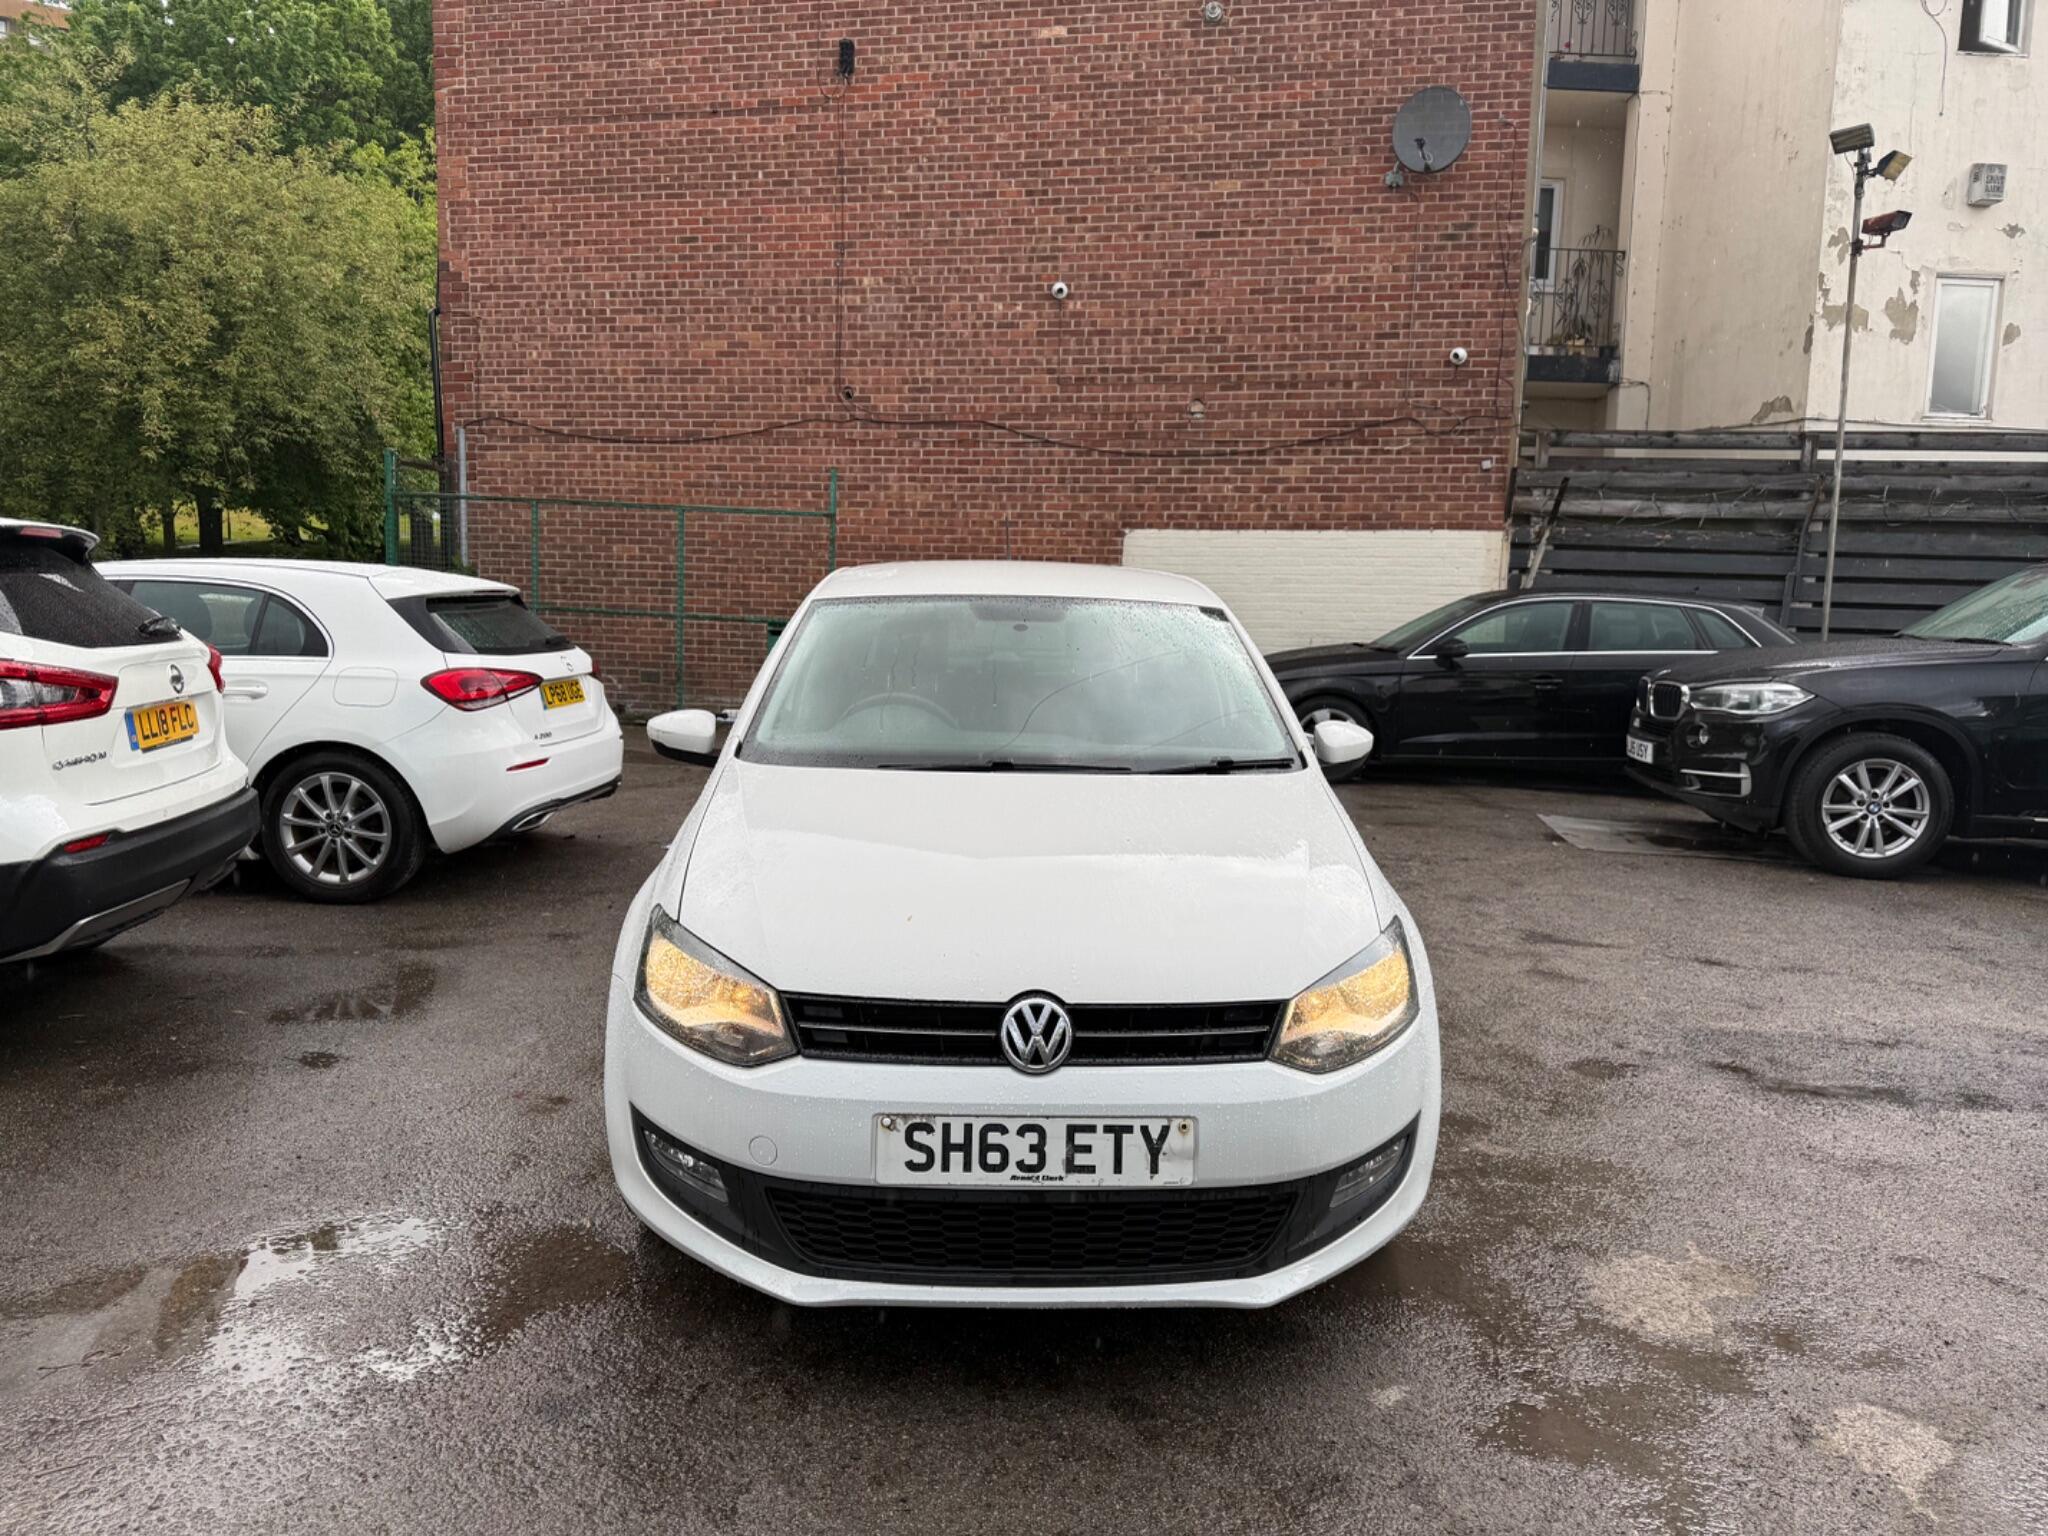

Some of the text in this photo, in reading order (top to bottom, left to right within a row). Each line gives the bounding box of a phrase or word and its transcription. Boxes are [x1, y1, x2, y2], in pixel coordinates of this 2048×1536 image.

[138, 703, 194, 740] LL18 FLC
[904, 1122, 1171, 1175] SH63 ETY
